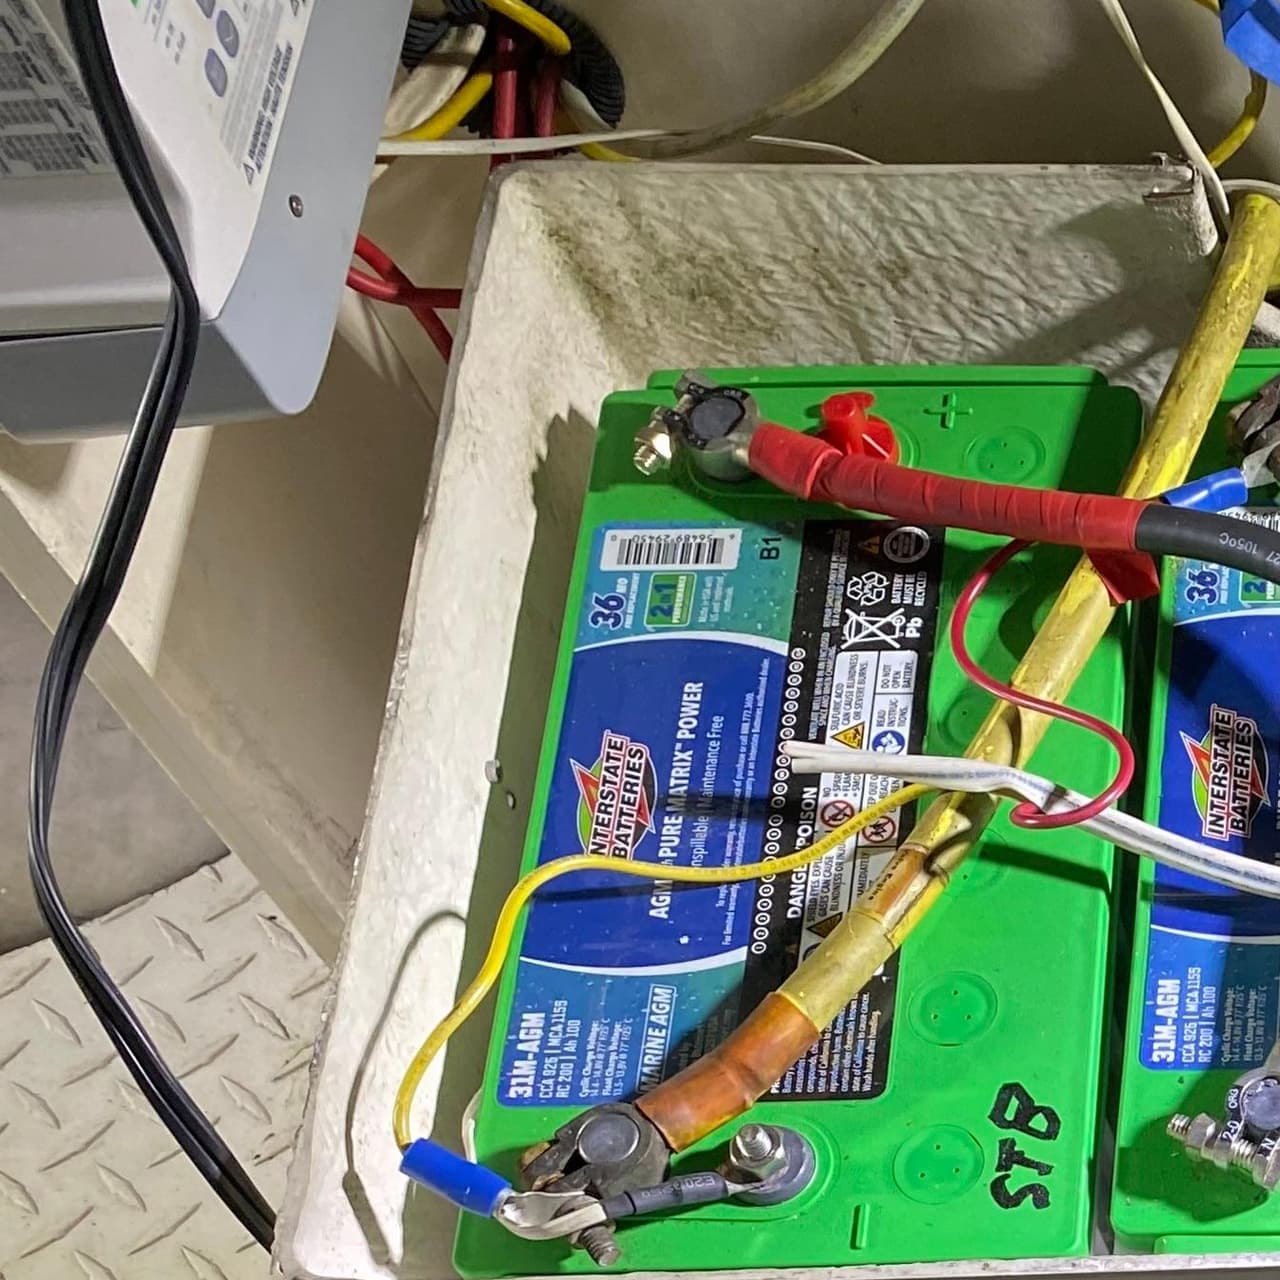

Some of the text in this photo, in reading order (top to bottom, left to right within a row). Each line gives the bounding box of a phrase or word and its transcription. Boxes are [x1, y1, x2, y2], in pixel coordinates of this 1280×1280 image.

[759, 536, 781, 560] B1
[587, 593, 626, 627] 36
[891, 573, 904, 603] BATTERY
[902, 574, 915, 603] MUST BE
[914, 570, 927, 605] RECYCLED
[1184, 566, 1220, 606] 36
[905, 616, 923, 637] Pb
[589, 737, 624, 856] NTERSTATE
[612, 746, 644, 858] BATTERIES
[658, 815, 682, 856] PURE
[676, 682, 703, 738] POWER
[688, 715, 724, 865] nspillable Maintenance Free
[1204, 713, 1234, 834] INTERSTATE
[1227, 719, 1254, 830] BATTERIES
[1185, 991, 1199, 1011] MCA
[1186, 967, 1201, 988] 1155
[508, 1012, 545, 1097] 31M-AGM
[556, 1019, 580, 1097] RC 200 Ah 100
[639, 988, 673, 1091] MARINE AGM
[1150, 979, 1181, 1062] 31M-AGM
[1182, 1042, 1195, 1061] CCA
[1198, 986, 1215, 1061] RC 200 Ah 100
[539, 1078, 555, 1097] CCA
[547, 1024, 563, 1046] MCA
[991, 1083, 1061, 1211] STB
